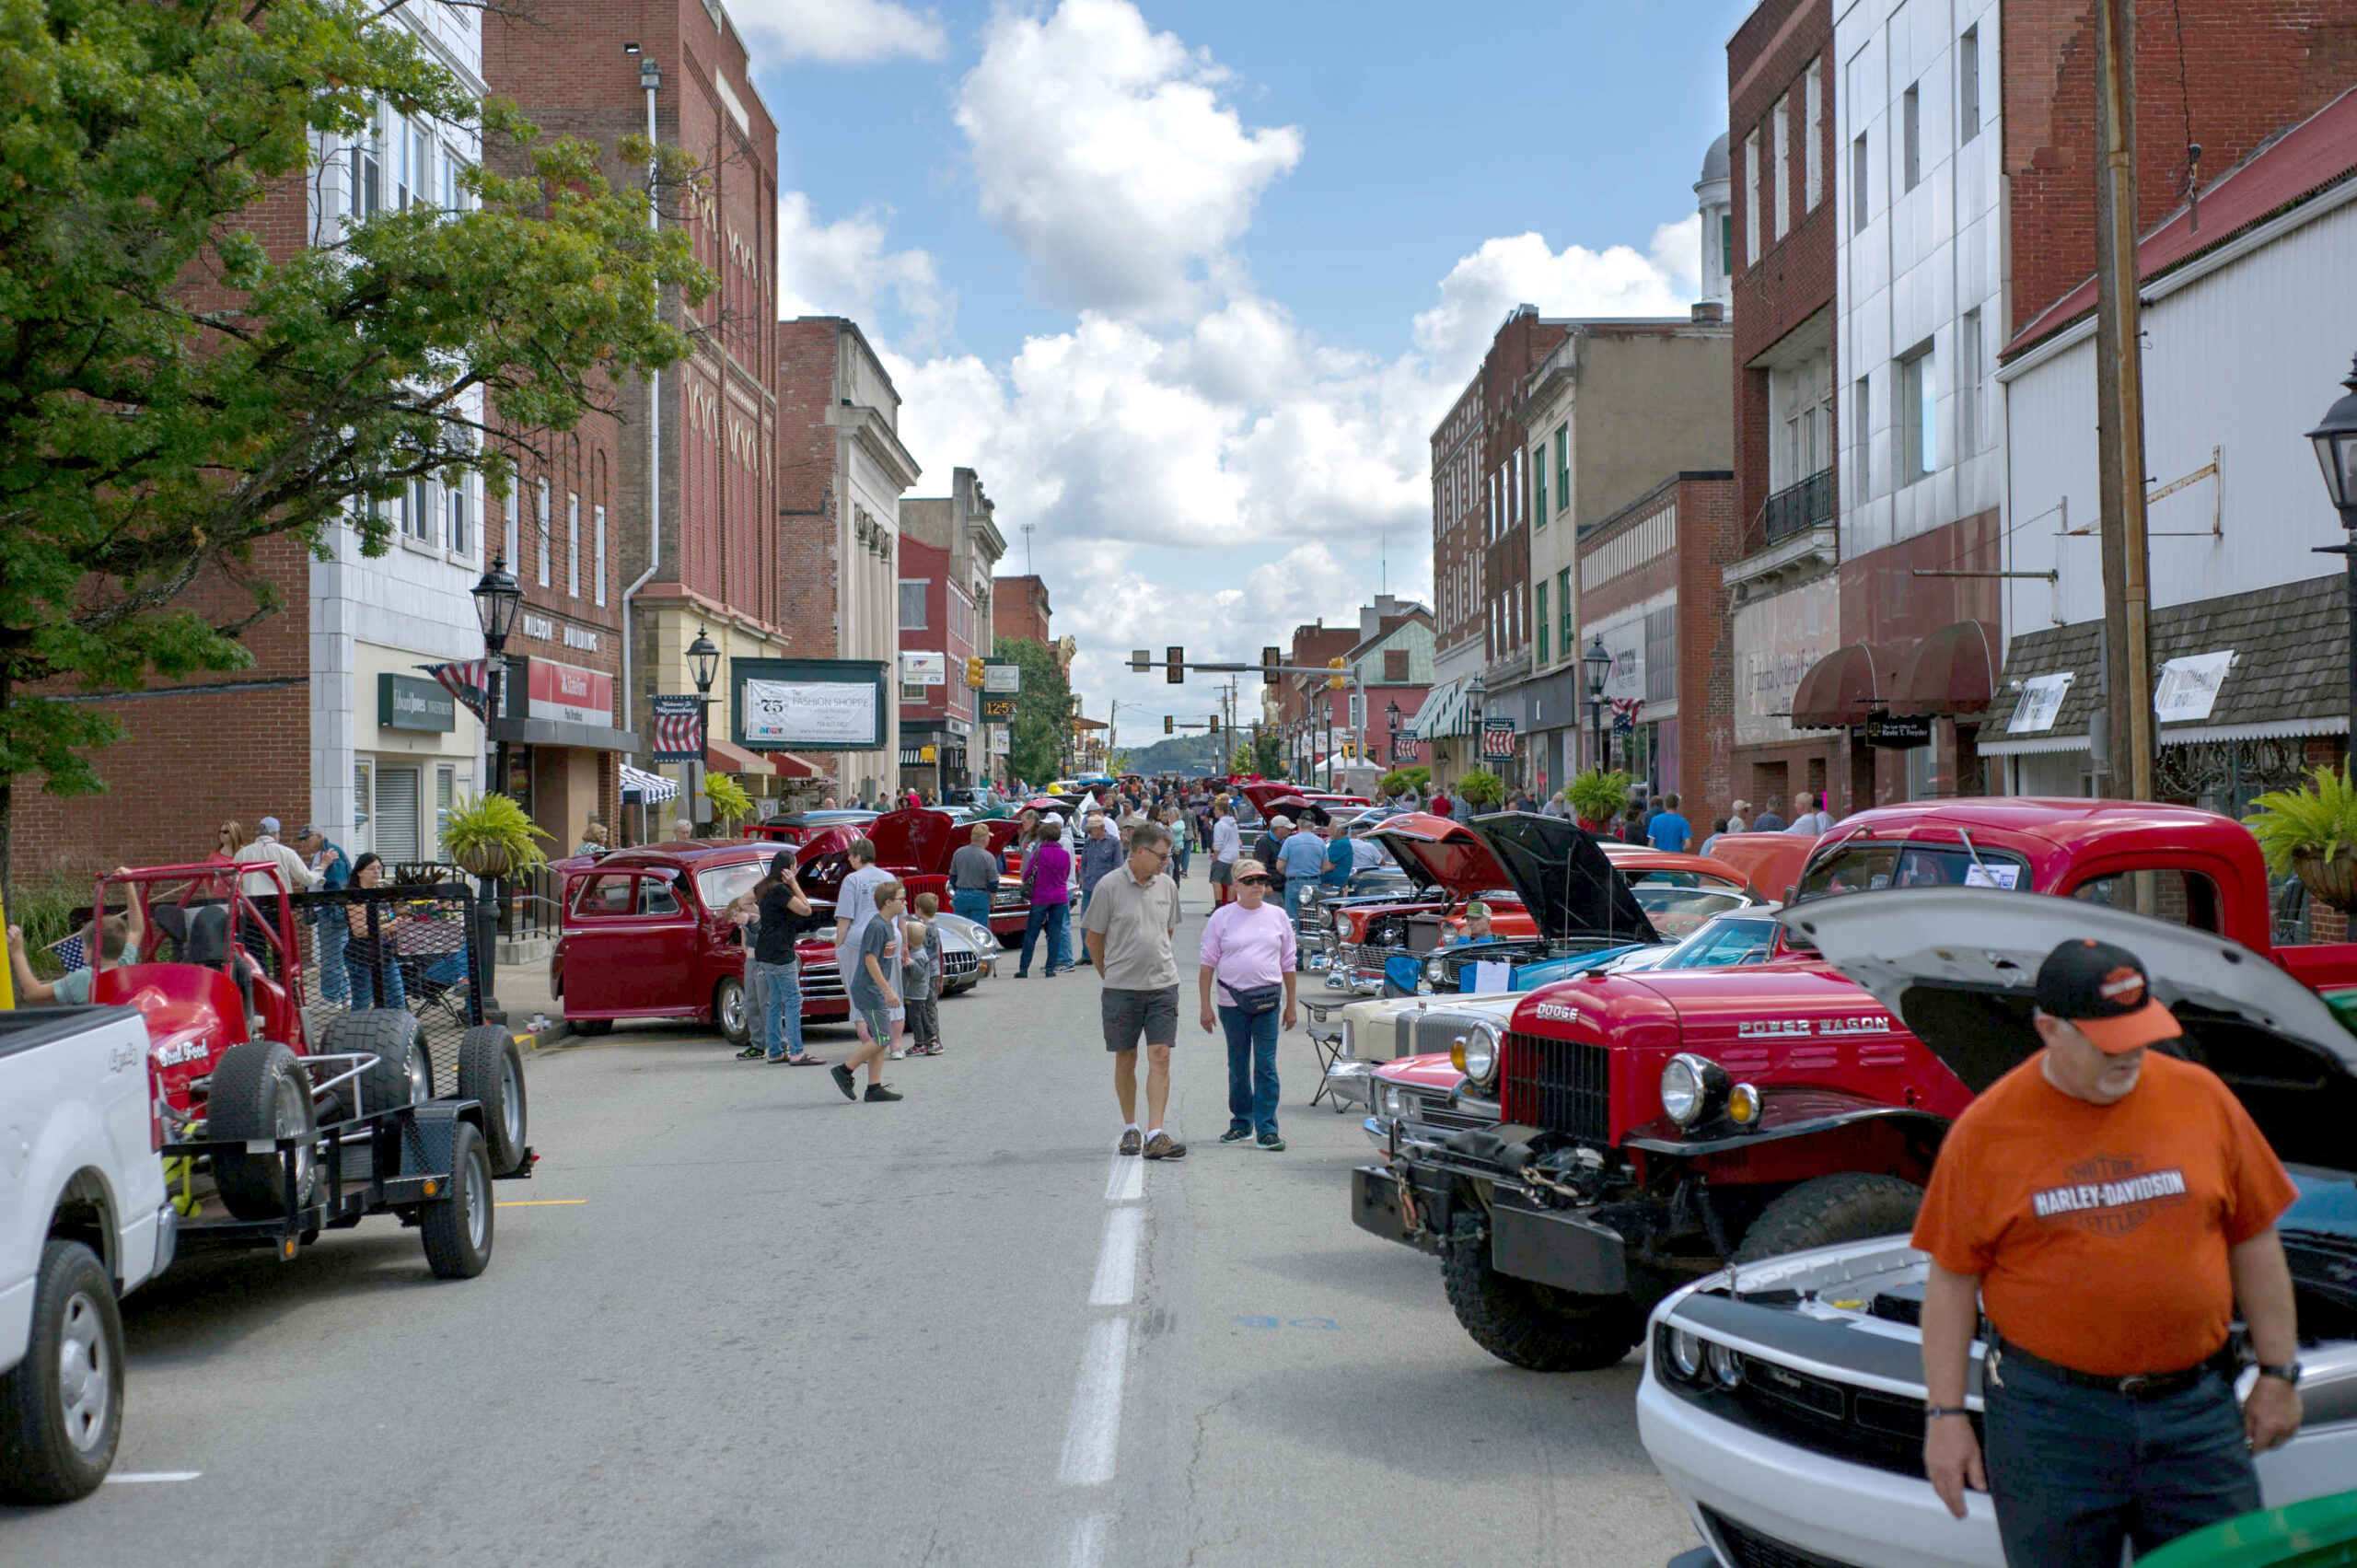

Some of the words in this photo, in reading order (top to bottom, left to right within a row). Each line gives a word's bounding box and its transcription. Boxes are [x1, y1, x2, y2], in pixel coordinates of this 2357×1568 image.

[523, 614, 552, 641] WILSON
[563, 627, 597, 652] BUILDING
[656, 706, 698, 715] Waynesburg
[761, 700, 784, 713] 75
[793, 697, 830, 707] FASHION
[833, 698, 868, 707] SHOPPE
[1538, 1003, 1578, 1021] DODGE
[1738, 1019, 1810, 1035] POWER
[1818, 1016, 1888, 1032] WAGON
[158, 1043, 184, 1068] Soul
[183, 1038, 209, 1062] Food
[2034, 1169, 2186, 1216] HARLEY-DAVIDSON
